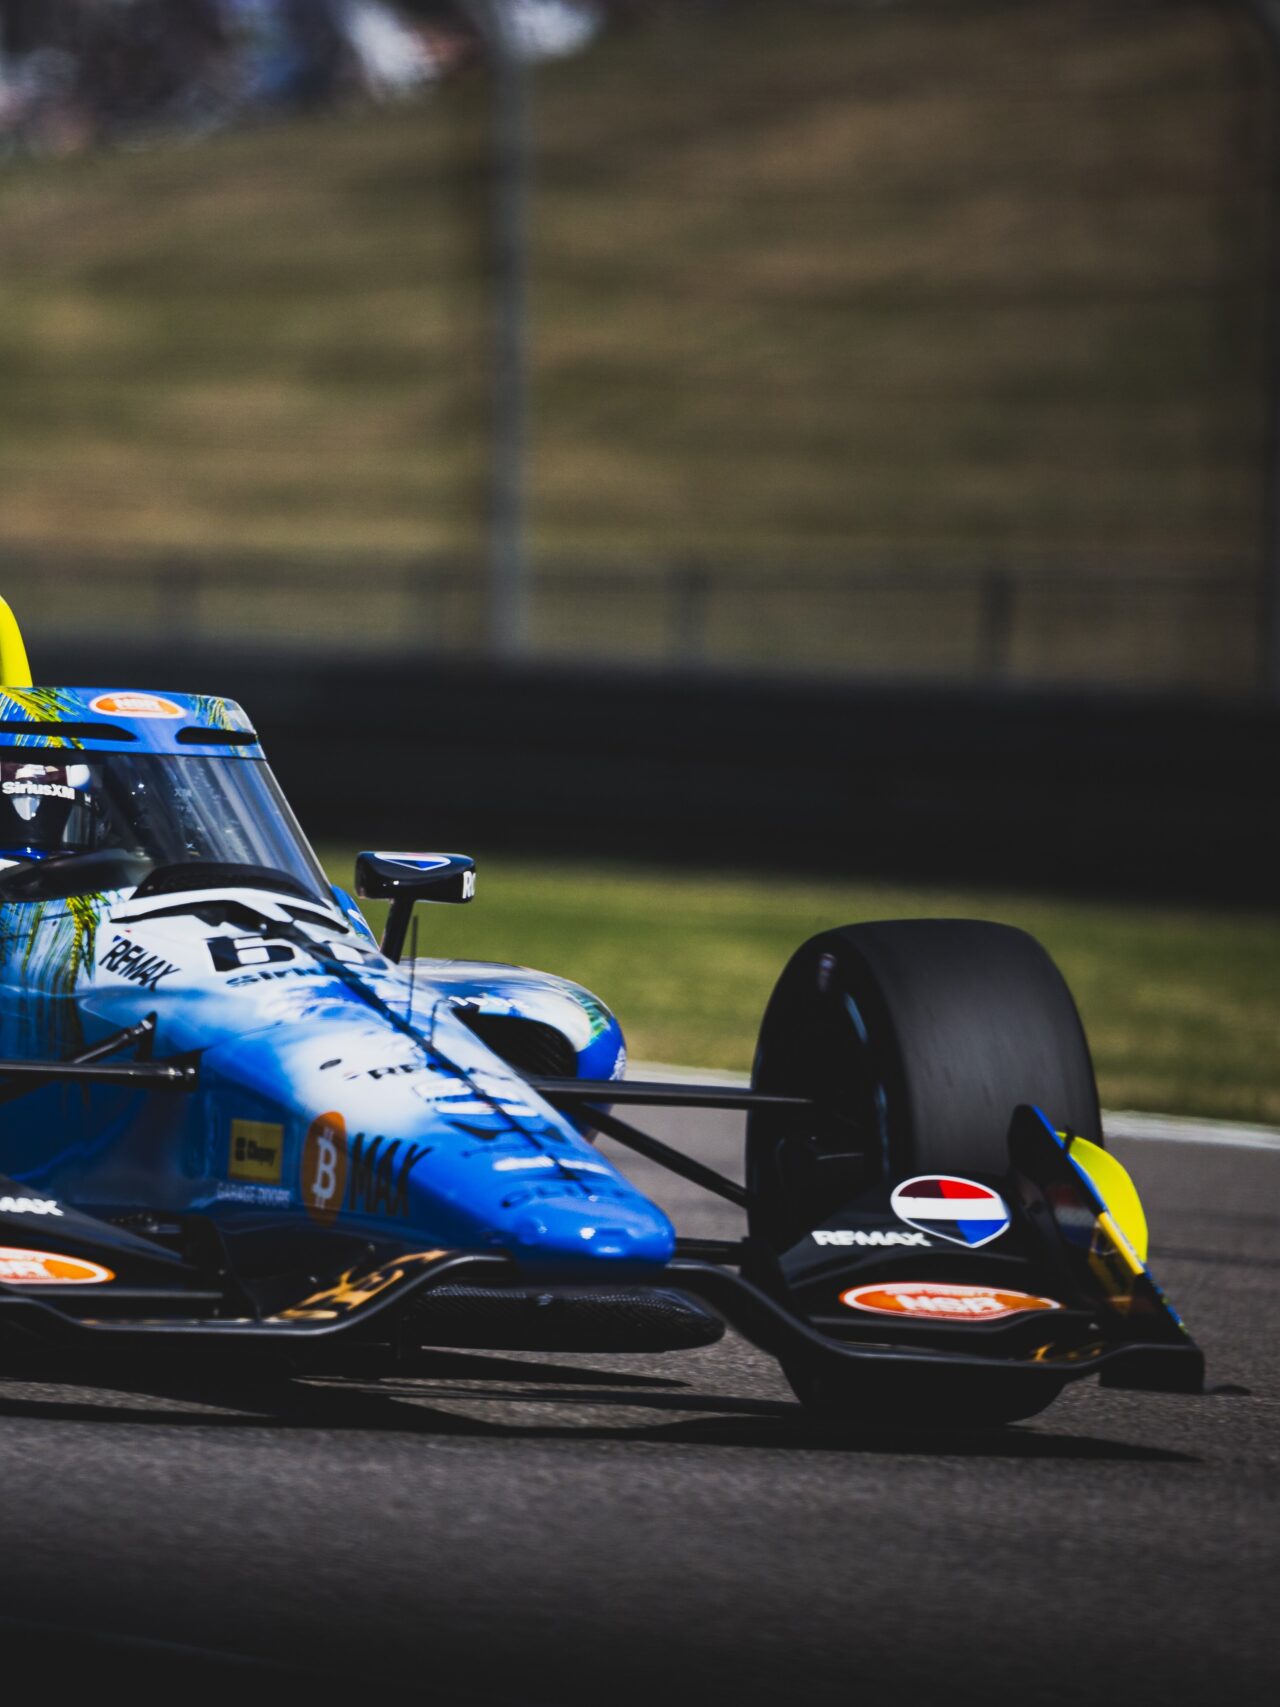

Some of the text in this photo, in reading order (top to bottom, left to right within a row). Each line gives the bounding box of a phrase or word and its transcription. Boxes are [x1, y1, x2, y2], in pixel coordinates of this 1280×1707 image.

[1, 780, 76, 800] SiriusXM
[98, 939, 181, 992] REMAX
[811, 1230, 933, 1247] REMAX
